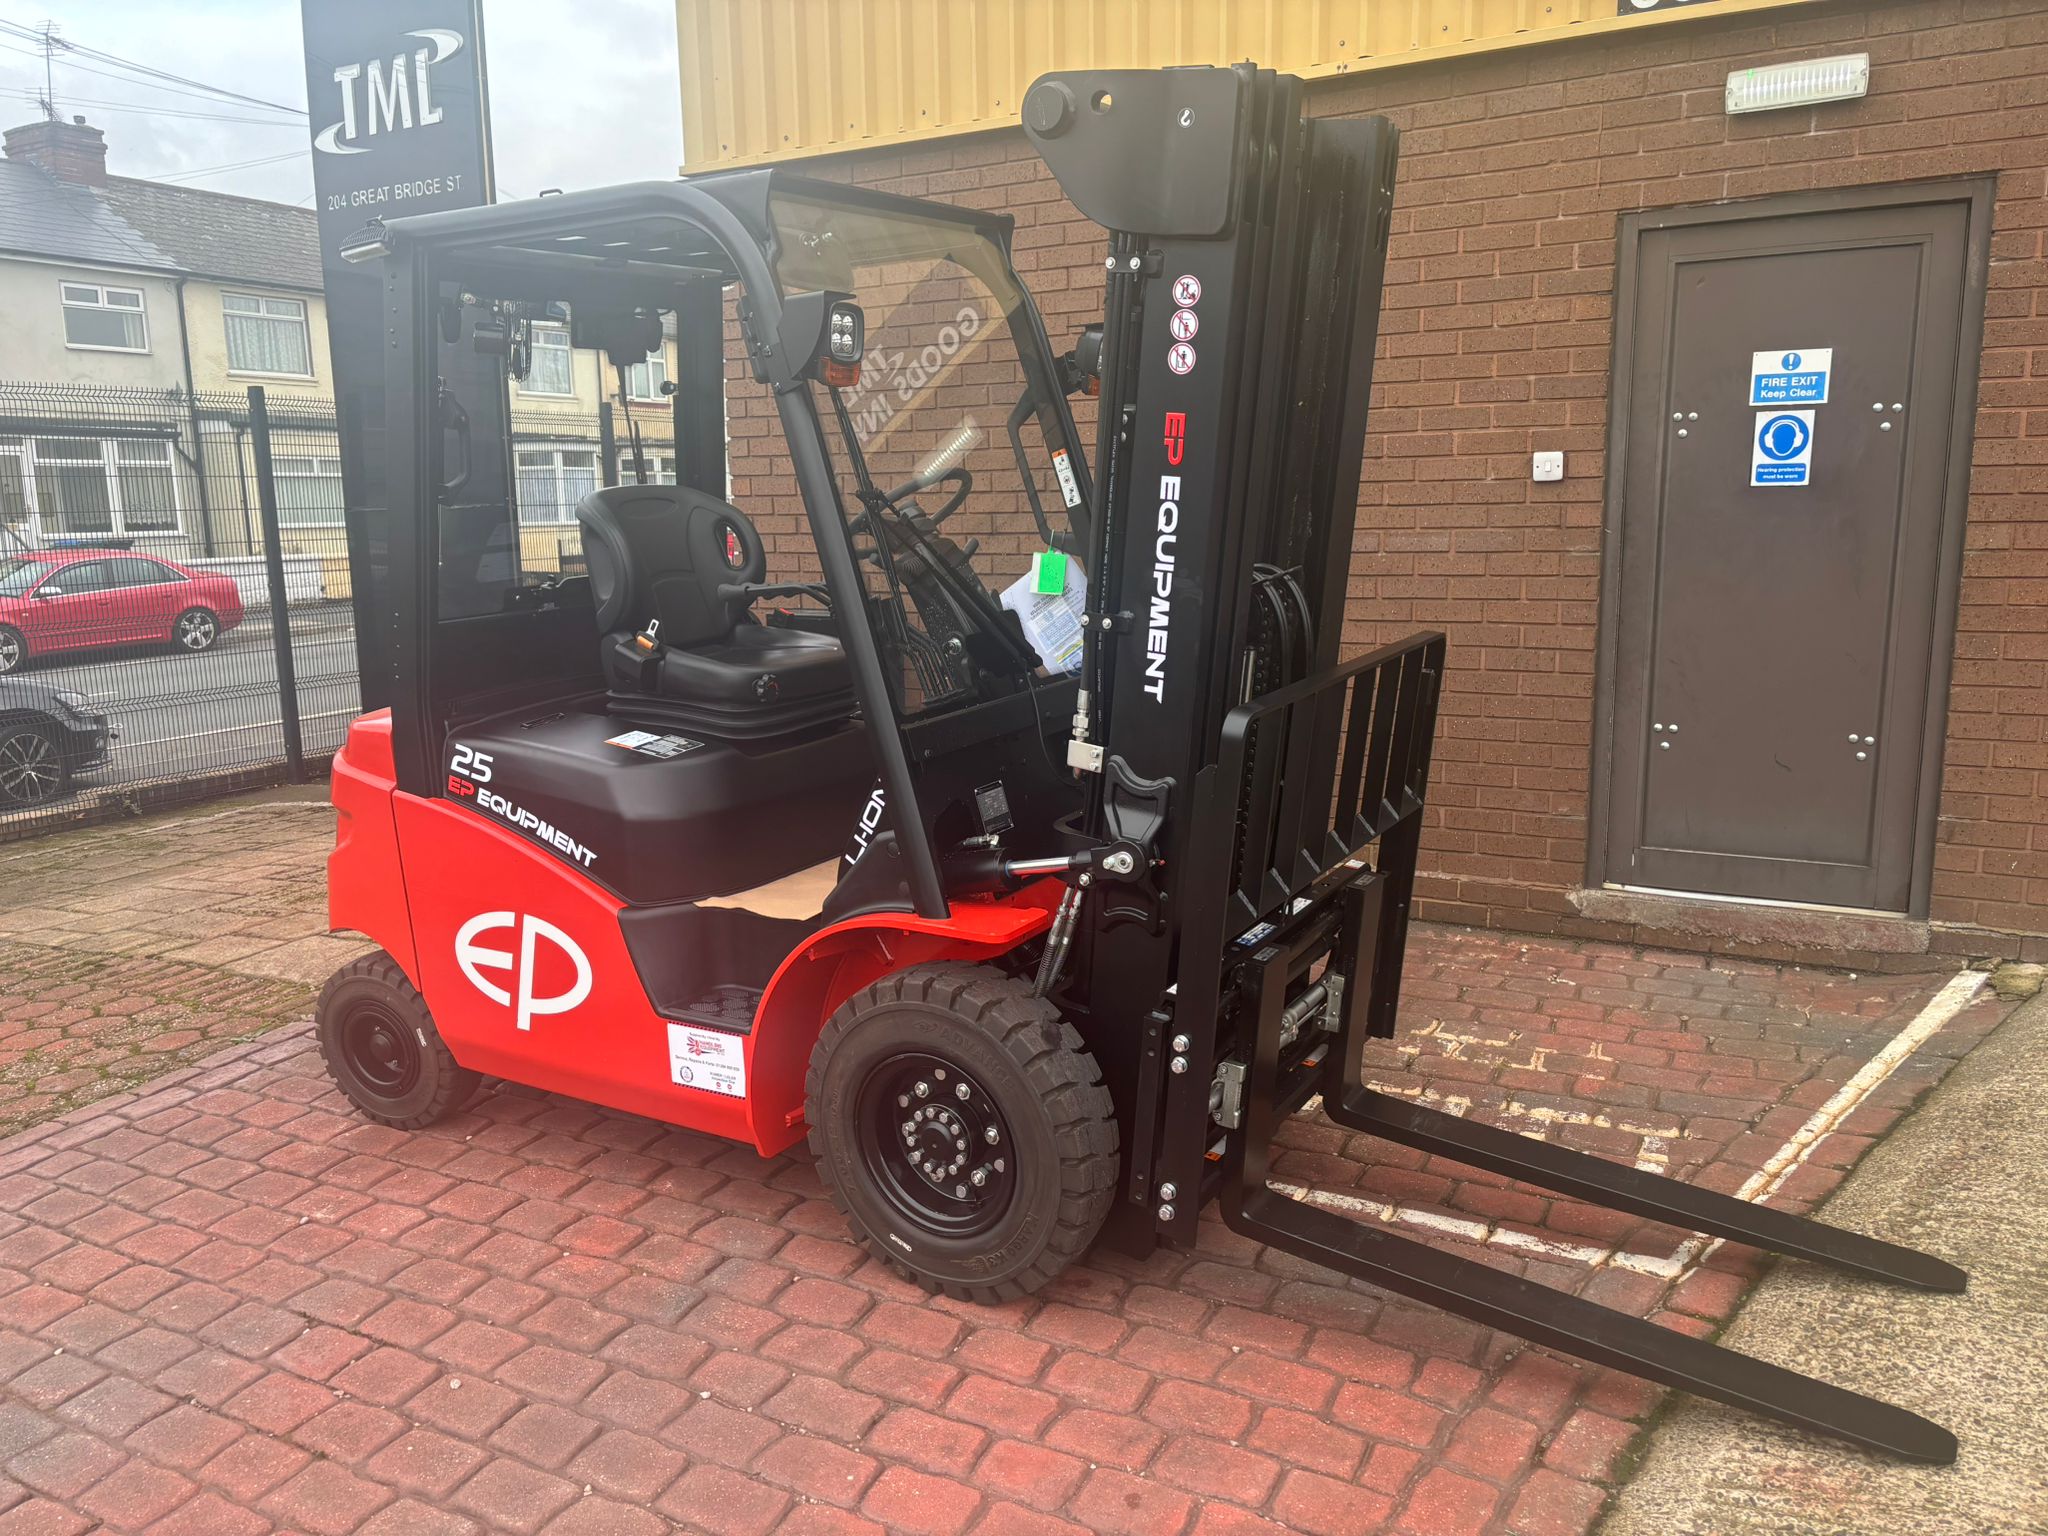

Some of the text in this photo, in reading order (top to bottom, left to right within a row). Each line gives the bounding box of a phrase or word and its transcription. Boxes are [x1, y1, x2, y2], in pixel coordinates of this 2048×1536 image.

[333, 48, 443, 140] TML
[328, 174, 462, 211] 204 GREAT BRIDGE ST
[1760, 388, 1816, 400] Keep Clear
[1761, 375, 1818, 388] FIRE EXIT
[1144, 412, 1186, 703] EP EQUIPMENT
[450, 743, 494, 783] 25
[447, 774, 598, 868] EP EQUIPMENT
[454, 910, 593, 1031] EP
